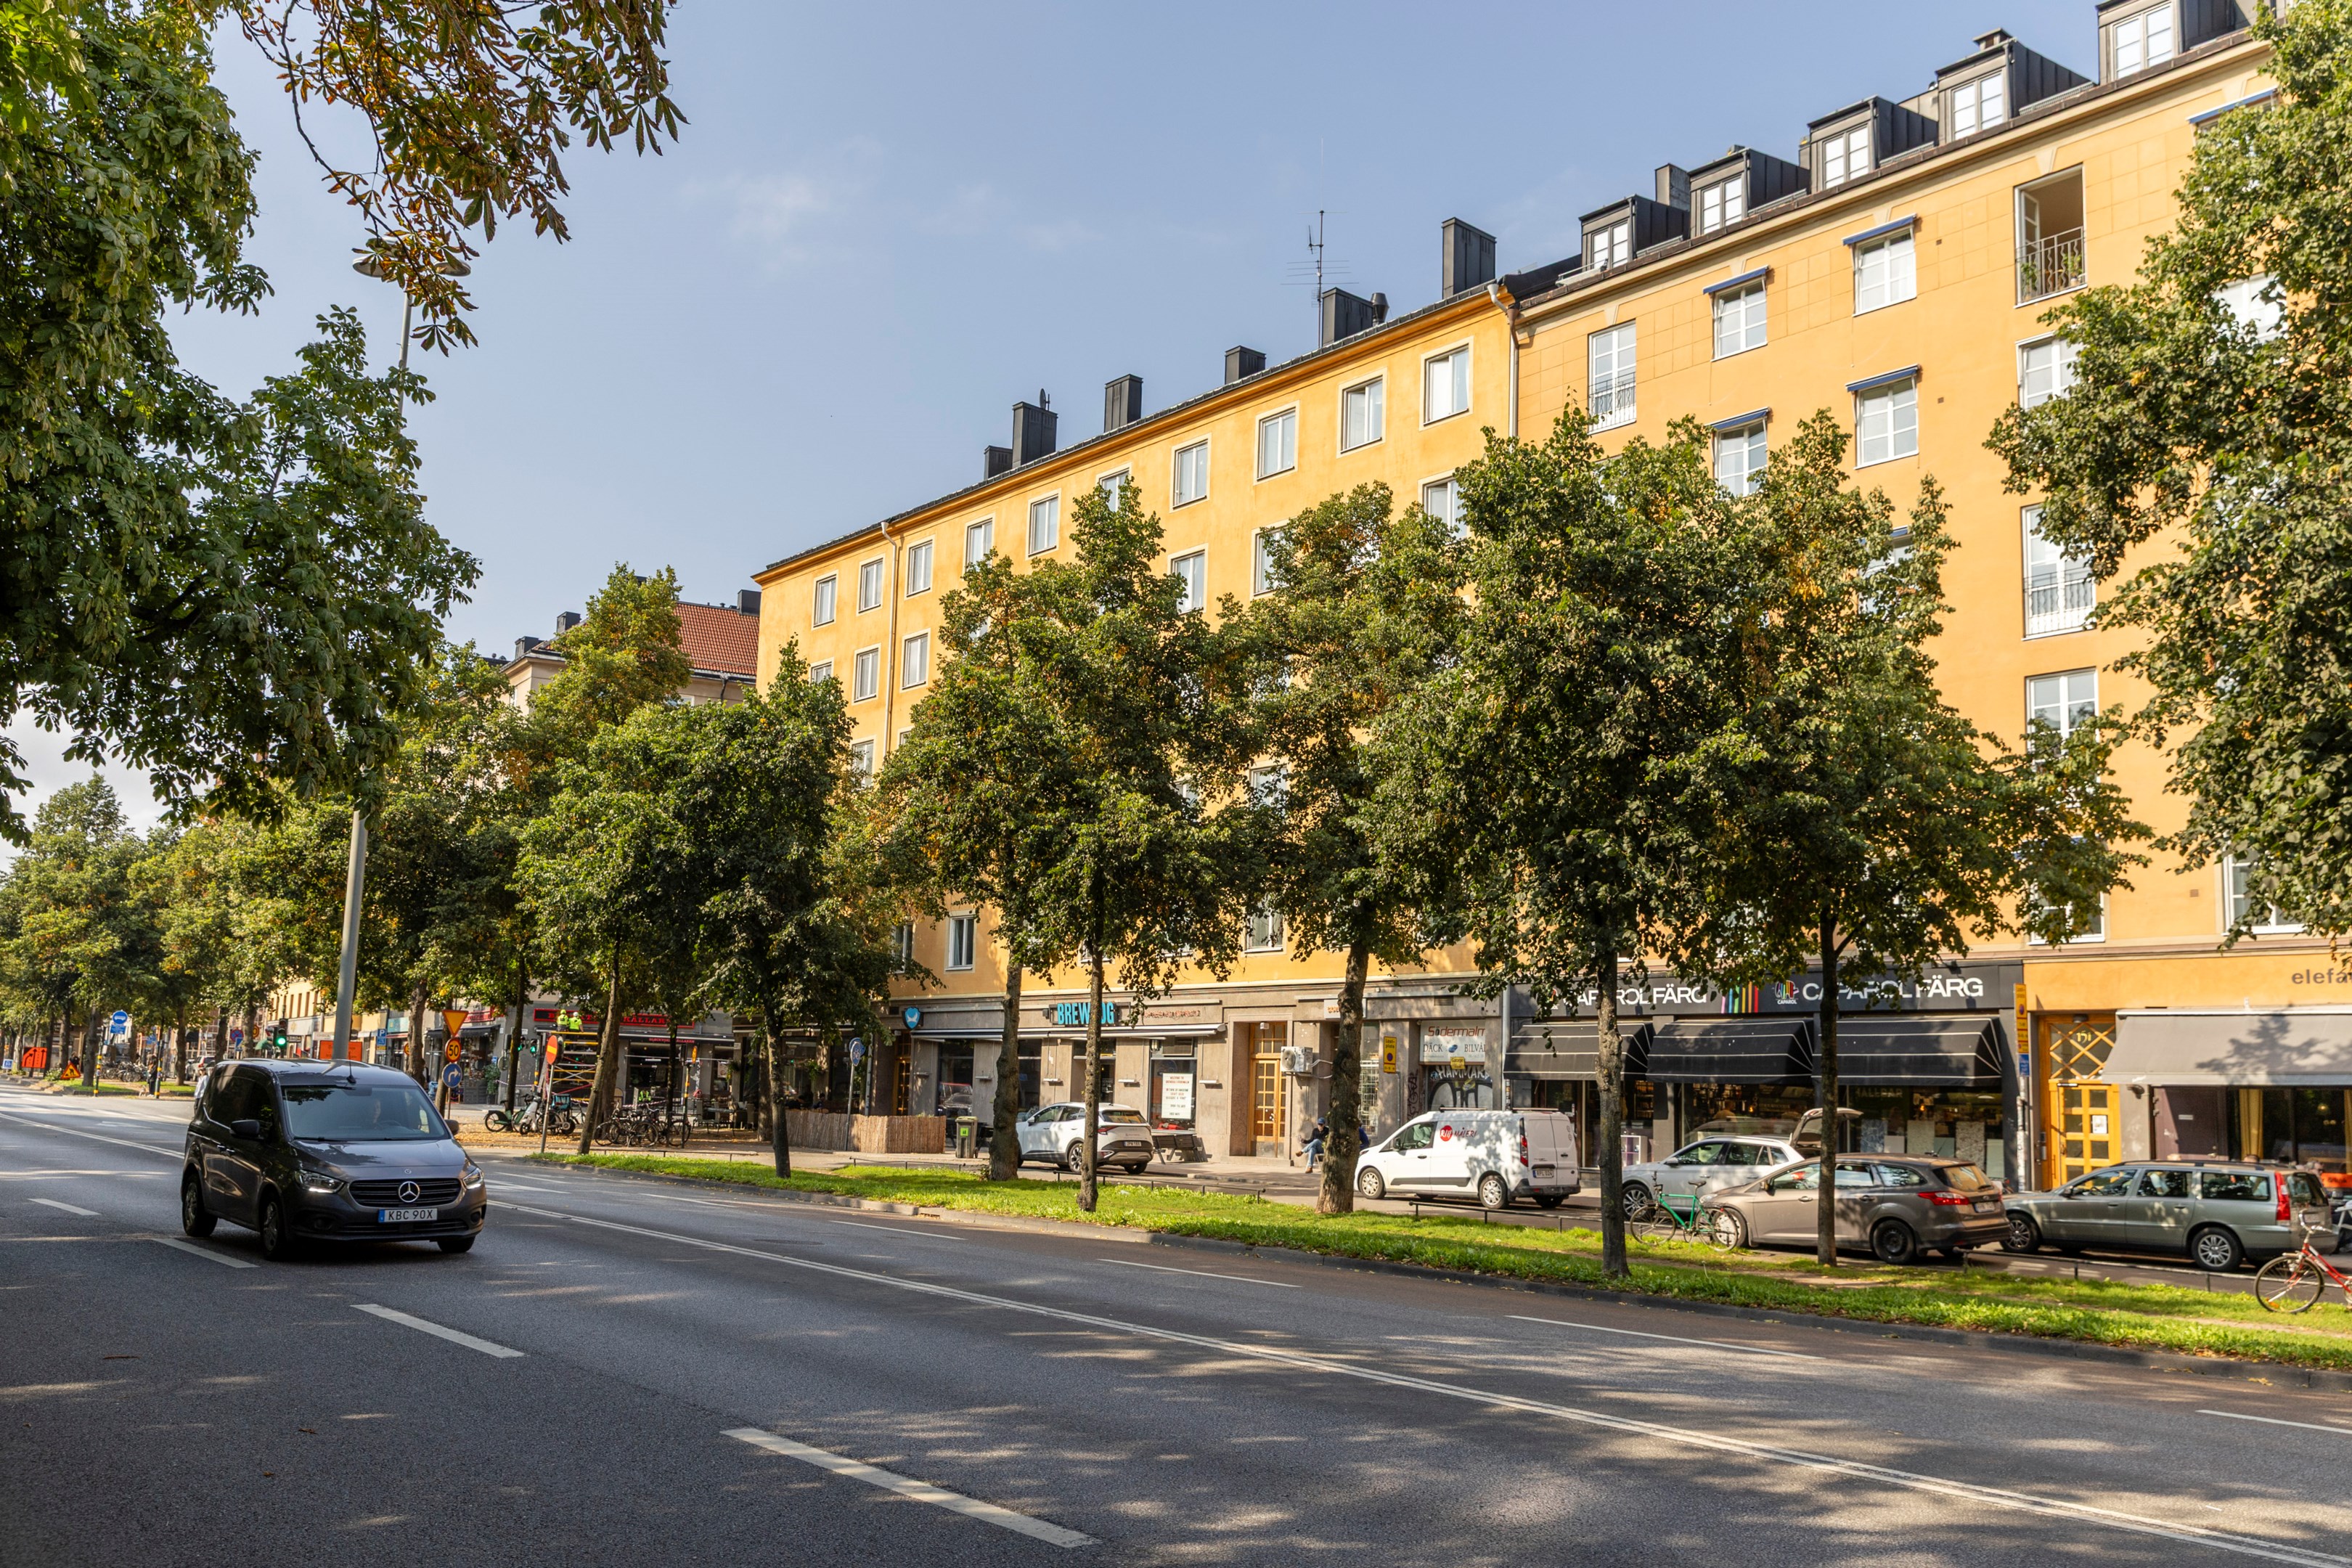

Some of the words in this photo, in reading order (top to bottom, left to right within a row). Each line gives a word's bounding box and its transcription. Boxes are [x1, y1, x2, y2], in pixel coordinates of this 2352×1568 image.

[2291, 968, 2352, 984] elefa
[1653, 983, 1707, 1005] FÄRG
[1802, 980, 1914, 1001] CPAROL
[1916, 974, 1984, 998] FÄRG
[1057, 1001, 1115, 1025] BREWOG
[2076, 1029, 2092, 1044] 151
[449, 1045, 460, 1057] 50
[1423, 1042, 1443, 1053] DÄCK
[388, 1210, 409, 1220] KBC
[412, 1209, 433, 1220] 90X
